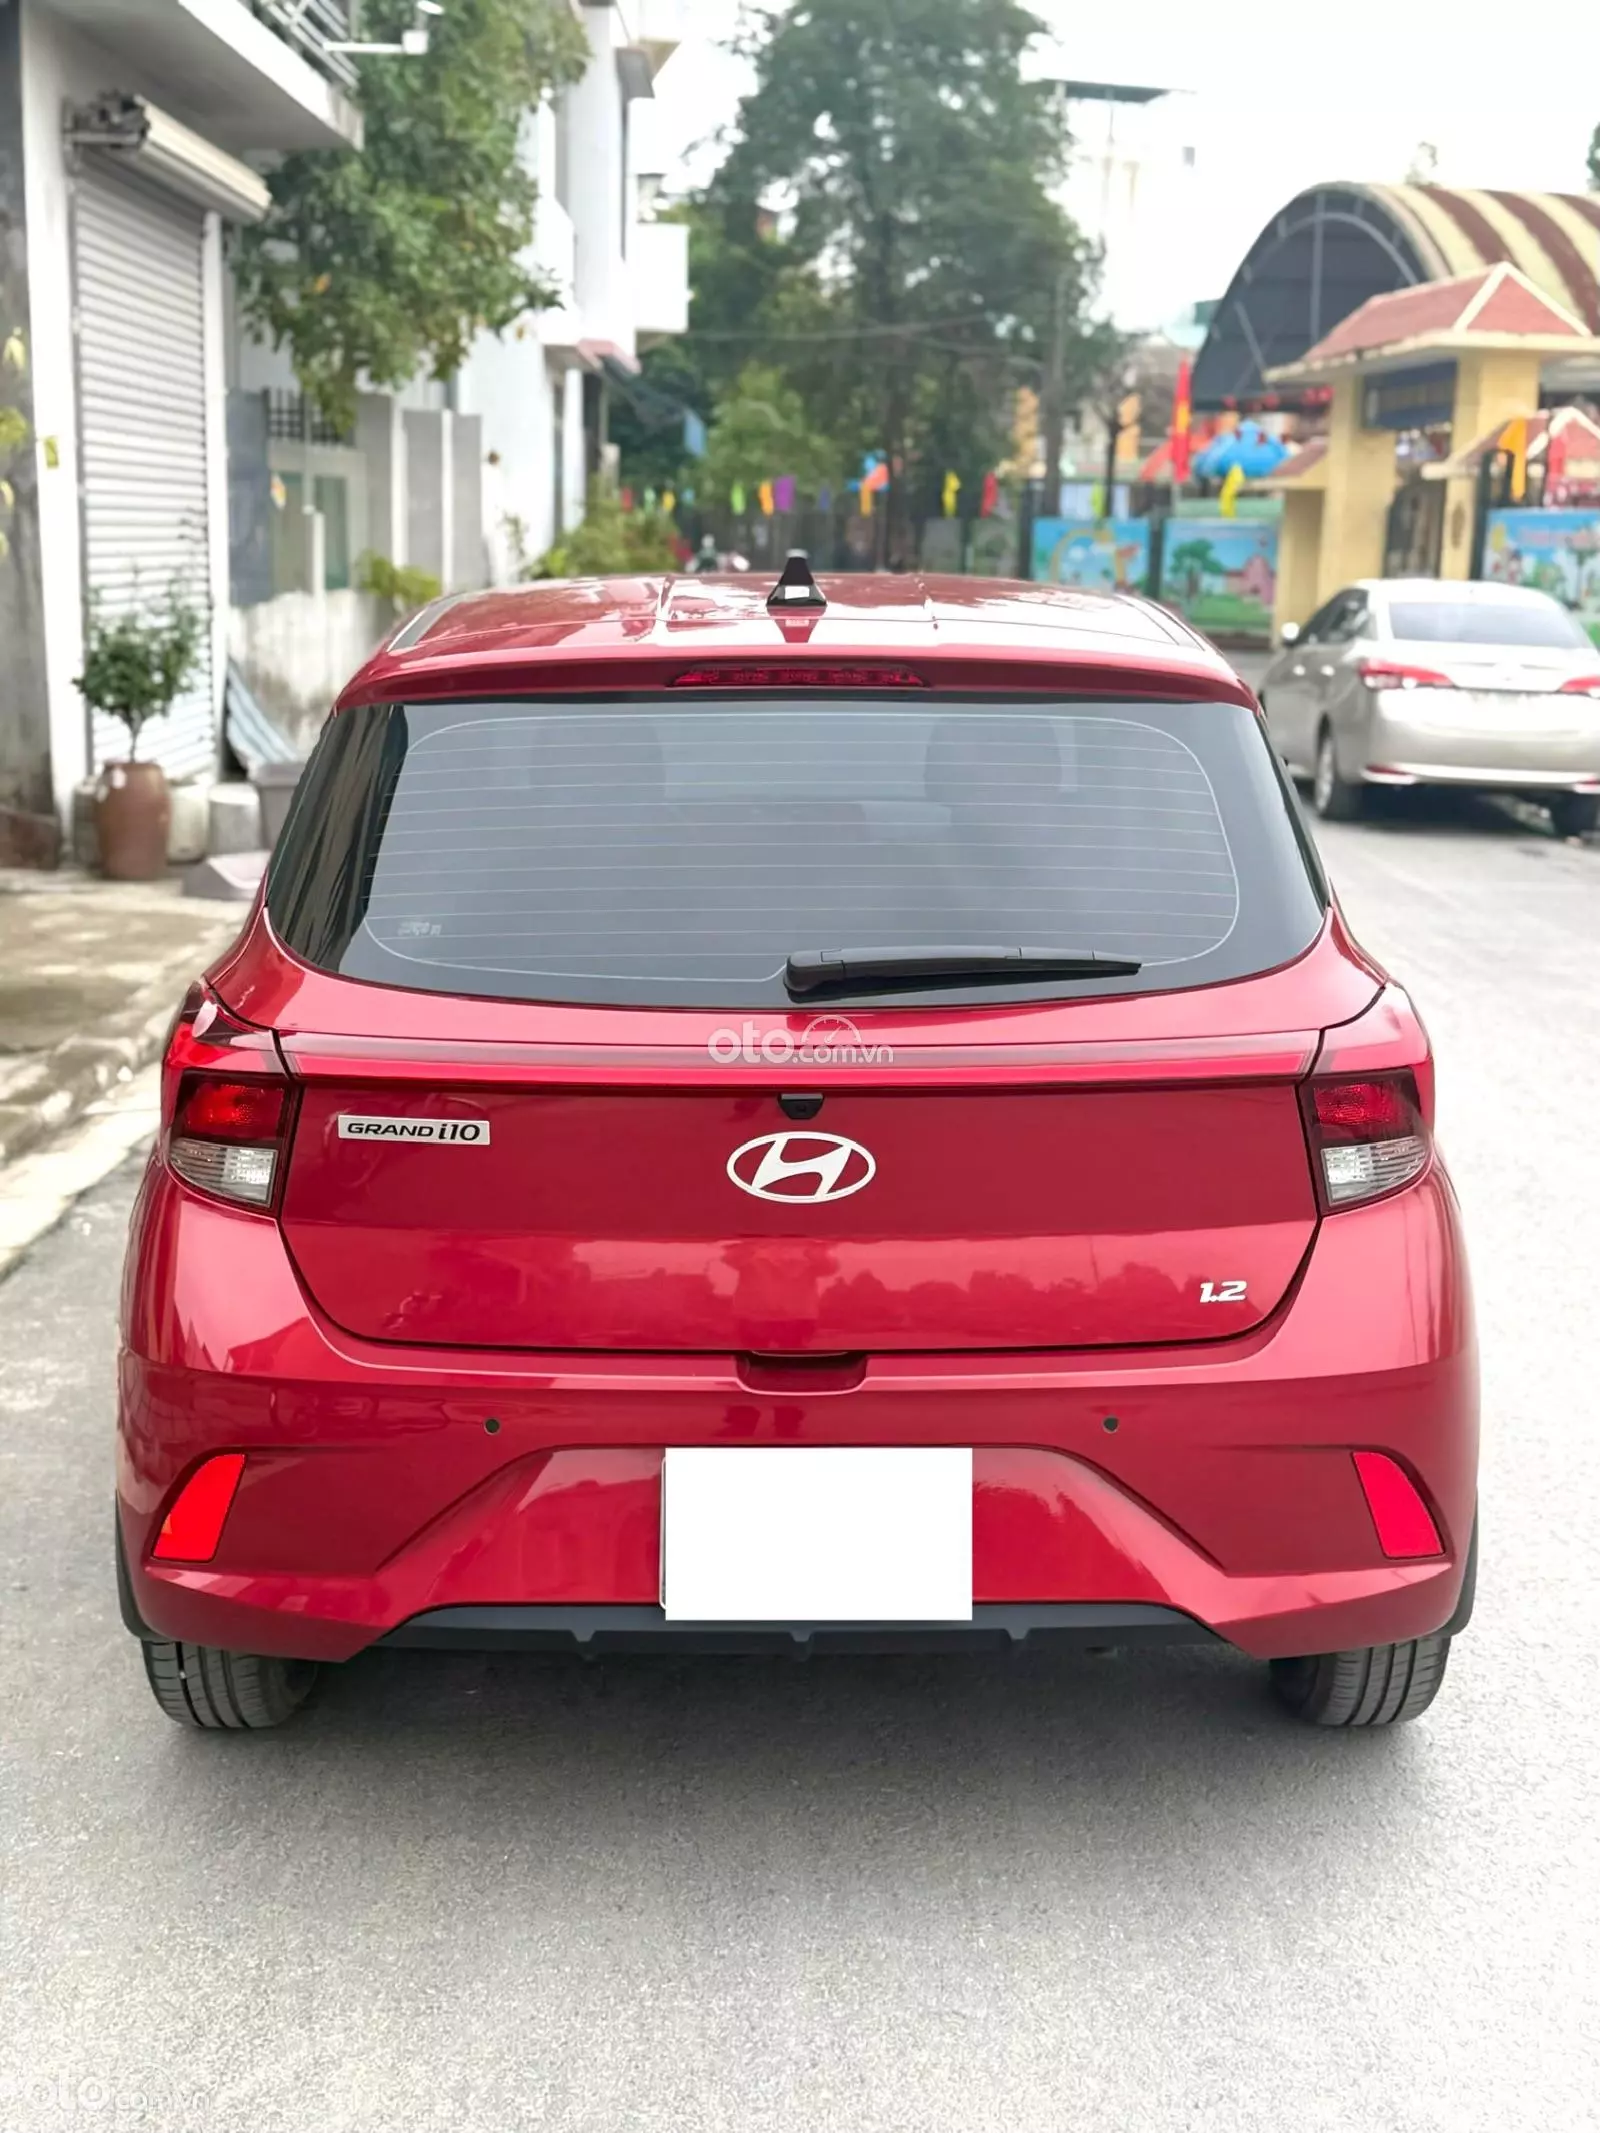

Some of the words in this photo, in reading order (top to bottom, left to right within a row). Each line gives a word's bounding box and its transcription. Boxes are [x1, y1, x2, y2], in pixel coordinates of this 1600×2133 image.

[347, 1123, 434, 1137] GRAND
[438, 1123, 481, 1141] i10
[1200, 1280, 1247, 1303] 1.2
